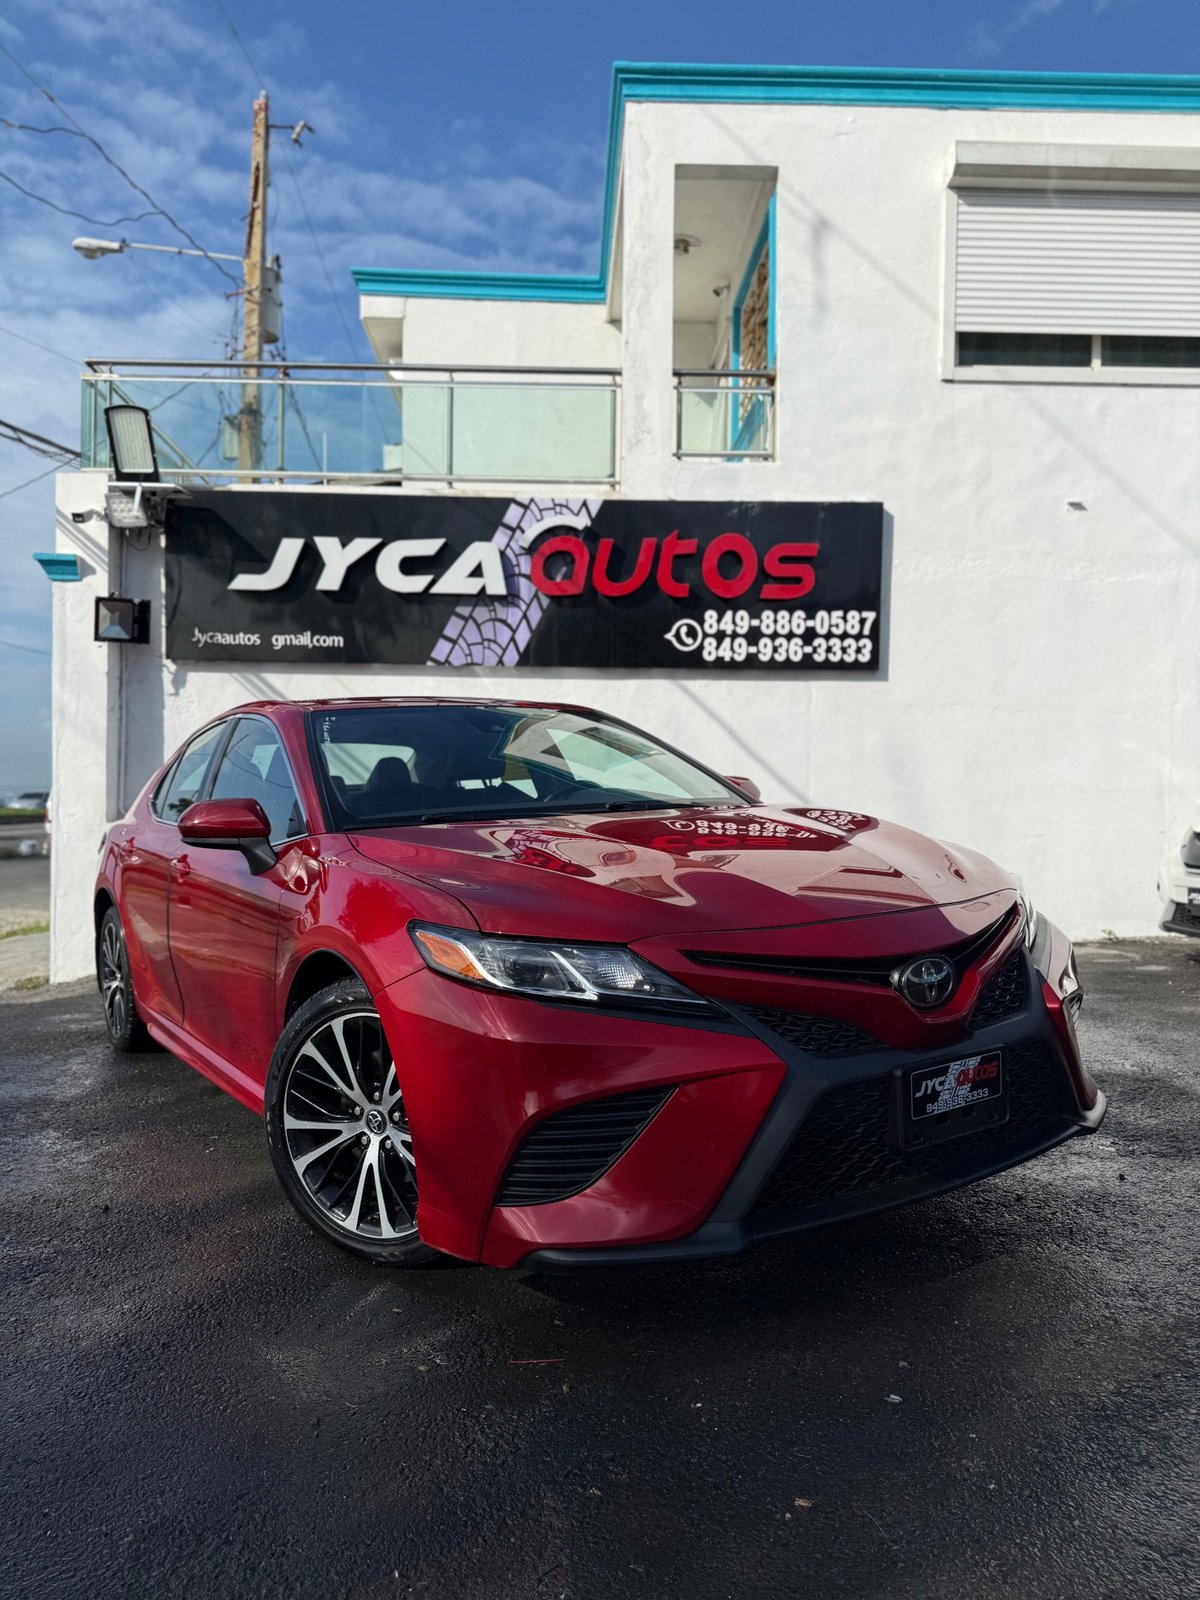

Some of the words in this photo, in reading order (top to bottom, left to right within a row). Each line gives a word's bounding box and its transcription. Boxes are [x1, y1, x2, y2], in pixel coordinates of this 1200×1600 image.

[227, 536, 507, 595] JYCA
[703, 609, 876, 635] 849-886-0587
[192, 627, 261, 647] Jycaautos
[702, 636, 872, 663] 849-936-3333
[914, 1074, 955, 1098] JYCA
